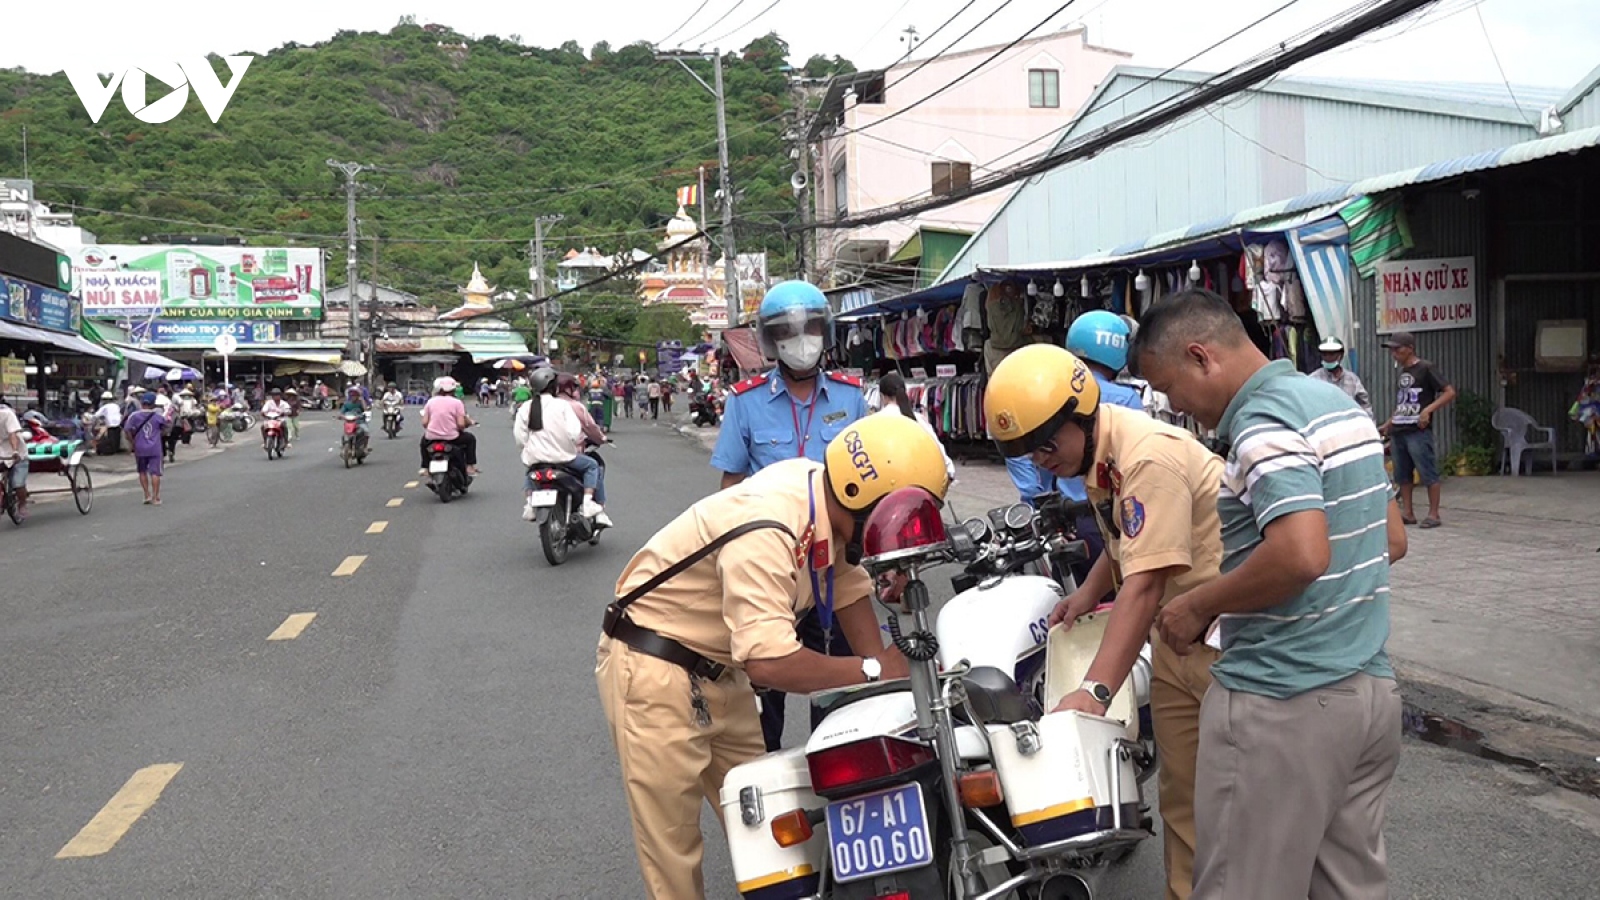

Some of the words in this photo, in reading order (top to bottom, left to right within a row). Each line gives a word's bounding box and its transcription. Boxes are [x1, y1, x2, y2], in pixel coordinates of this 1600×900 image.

[86, 275, 110, 286] NHÀ
[114, 275, 157, 286] KHÁCH
[1383, 266, 1421, 297] NHẬN
[1451, 267, 1469, 289] XE
[86, 286, 116, 305] NÚI
[121, 290, 159, 305] SAM
[1421, 305, 1429, 322] &
[1432, 304, 1446, 321] DU
[1448, 303, 1472, 323] LỊCH
[238, 326, 245, 334] 2
[1095, 331, 1126, 348] TTGT
[844, 430, 878, 481] CSGT
[1029, 613, 1050, 644] CS
[839, 791, 908, 836] 67-A1
[835, 826, 925, 875] 000.60
